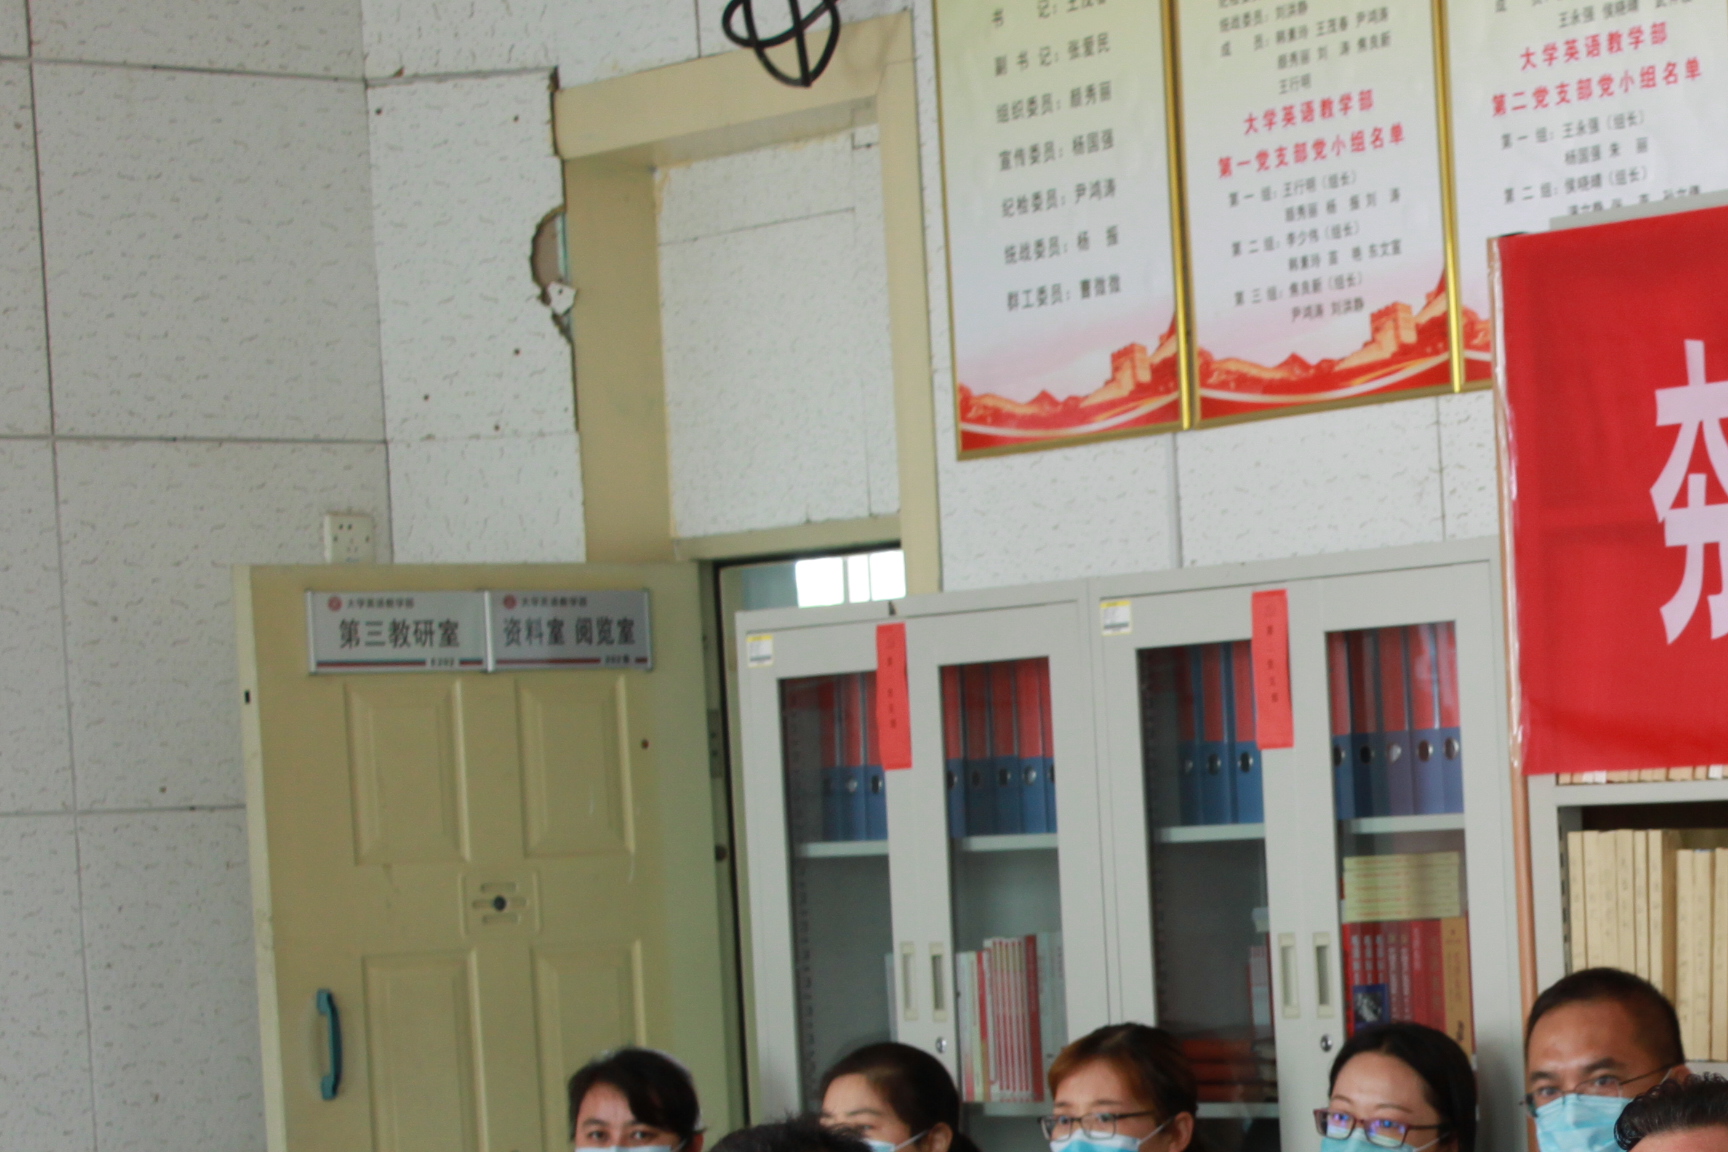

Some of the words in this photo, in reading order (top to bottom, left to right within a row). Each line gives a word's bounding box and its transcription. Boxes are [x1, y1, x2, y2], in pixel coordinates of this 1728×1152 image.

[1520, 21, 1667, 71] 大学英语教学部
[1492, 56, 1701, 117] 第二党支部党小组名单
[1244, 89, 1373, 135] 大学英语教学部
[1218, 121, 1405, 179] 第一党支部党小组名单
[339, 617, 460, 649] 第三教研室
[503, 616, 565, 647] 资料室
[575, 616, 635, 646] 阅览室
